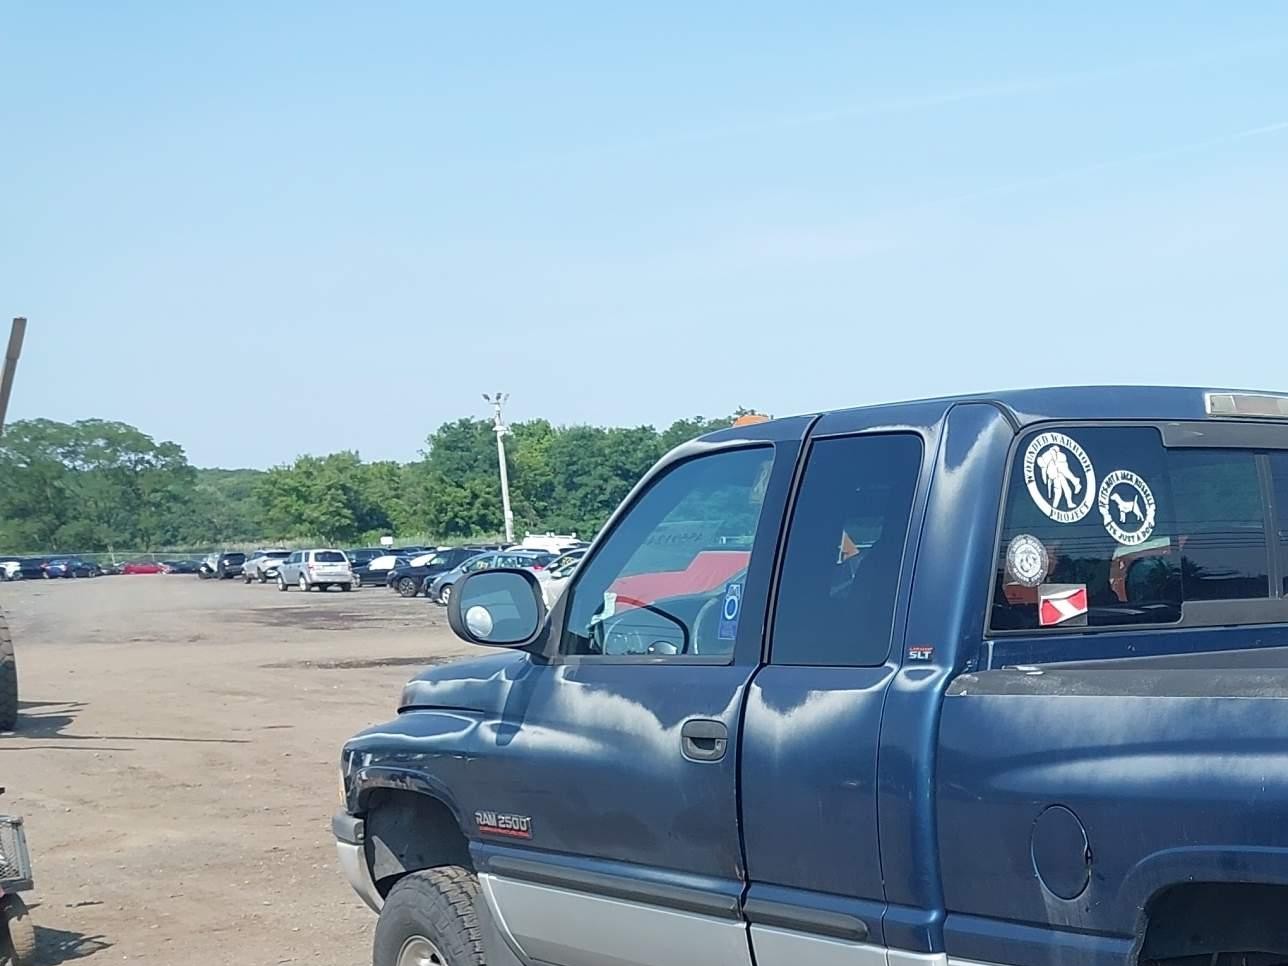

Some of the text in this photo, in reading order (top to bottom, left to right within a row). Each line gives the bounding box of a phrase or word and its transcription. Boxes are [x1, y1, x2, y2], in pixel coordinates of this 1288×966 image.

[1025, 433, 1092, 483] WOUNDED WARRIOR
[1050, 500, 1091, 521] PROJECT
[908, 651, 931, 659] SLT
[475, 811, 530, 831] RAM 2500
